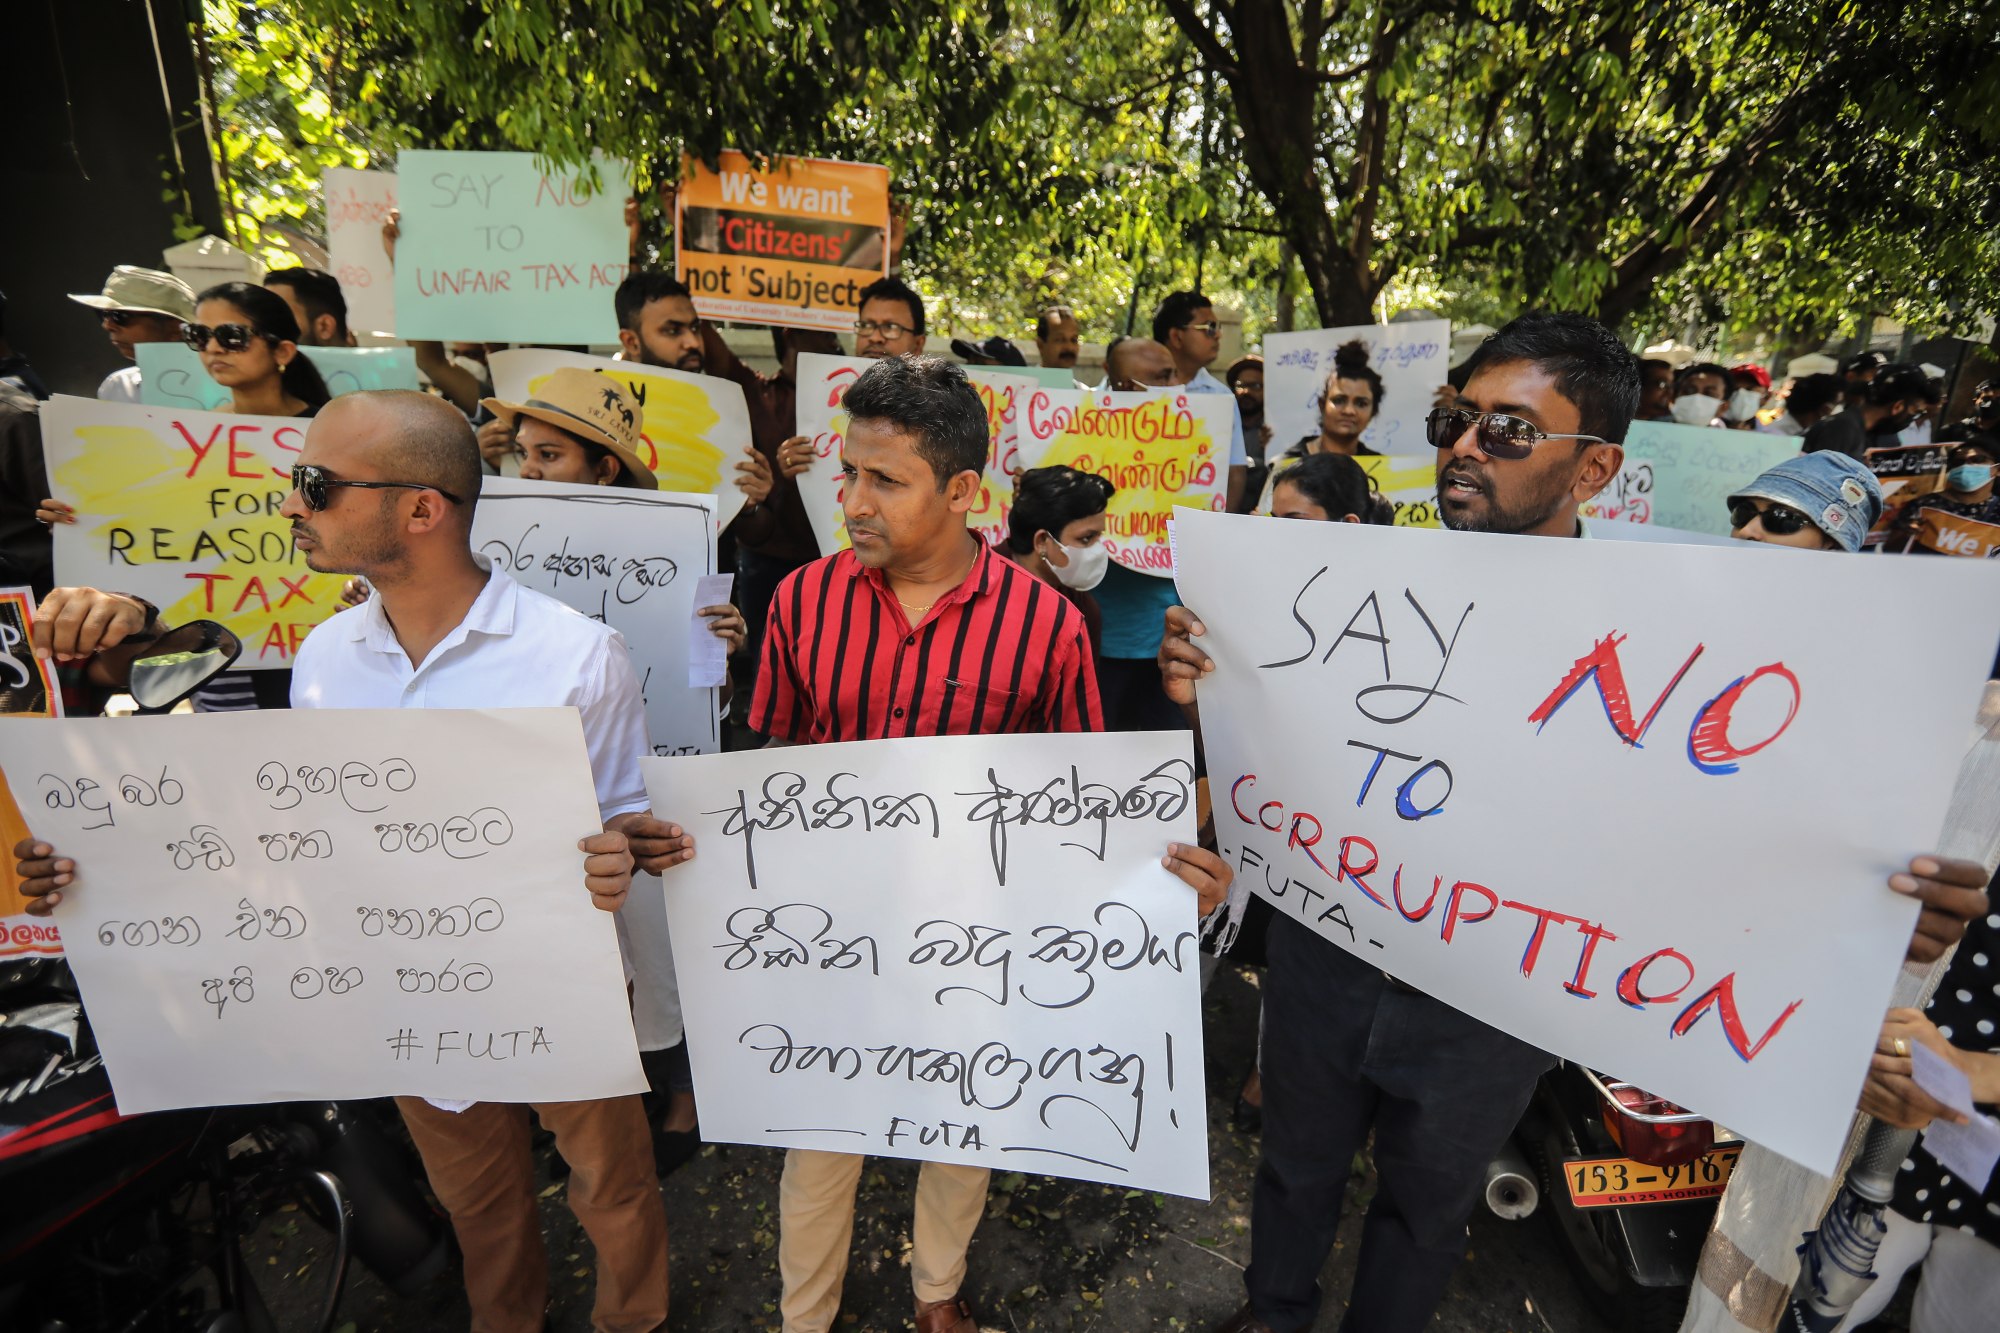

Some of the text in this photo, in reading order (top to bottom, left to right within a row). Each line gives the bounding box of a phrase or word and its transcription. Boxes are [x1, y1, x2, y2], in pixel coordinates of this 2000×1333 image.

[430, 172, 503, 210] SAY
[535, 176, 593, 208] NO
[720, 171, 853, 216] We want
[475, 224, 525, 252] TO
[416, 263, 629, 297] UNFAIR TAX ACT
[685, 265, 864, 308] not 'Subject
[587, 406, 633, 442] SRI LANKA
[1028, 391, 1194, 443] வேண்டும்
[171, 420, 304, 480] YES
[208, 488, 284, 519] FOR
[1936, 527, 1979, 556] We
[185, 573, 314, 614] TAX
[1258, 564, 1801, 776] SAY NO
[1347, 739, 1454, 822] TO
[258, 830, 333, 862] පත
[375, 807, 514, 859] පහලට
[98, 915, 201, 947] ගෙන
[1228, 772, 1804, 1063] CORRUPTION
[909, 919, 1012, 1007] බදු
[201, 958, 494, 1020] අපි මහ පාරට
[884, 1116, 988, 1151] FUTA
[1608, 1187, 1721, 1204] CB125 HONDA
